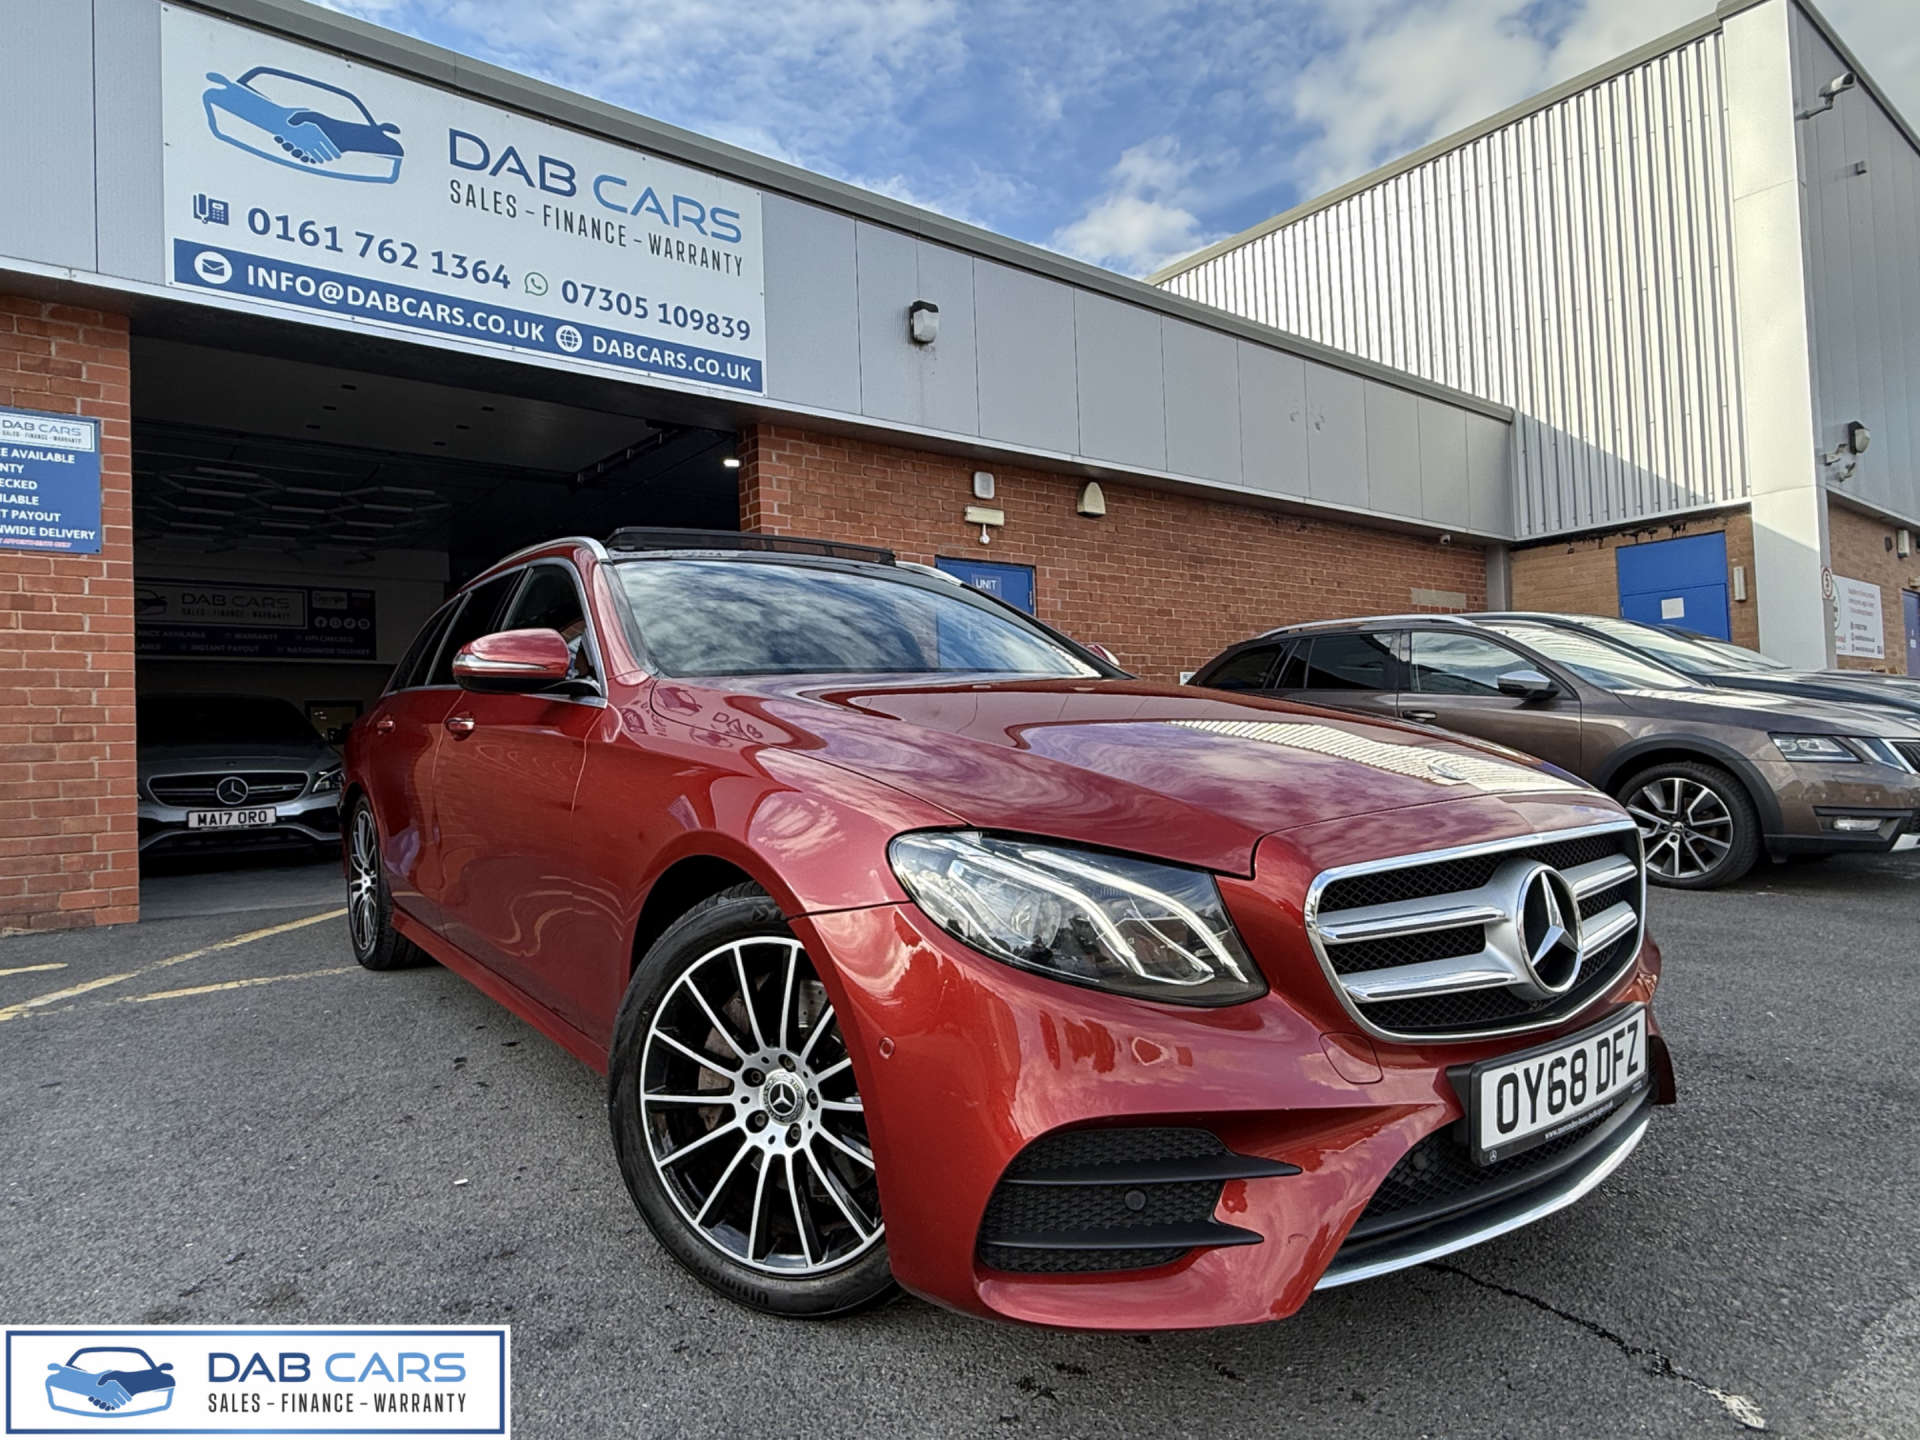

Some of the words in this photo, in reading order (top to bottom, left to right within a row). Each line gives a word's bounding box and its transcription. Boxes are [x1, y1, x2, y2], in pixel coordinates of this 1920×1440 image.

[449, 128, 577, 197] DAB
[593, 174, 742, 244] CARS
[450, 179, 517, 218] SALES
[543, 204, 627, 248] FINANCE
[648, 232, 743, 277] WARRANTY
[248, 207, 344, 253] 0161
[355, 231, 418, 269] 762
[431, 250, 511, 289] 1364
[561, 279, 649, 319] 07305
[657, 303, 751, 341] 109839
[247, 265, 545, 342] INFO@DABCARS.CO.UK
[592, 335, 752, 383] DABCARS.CO.UK
[2, 420, 35, 431] DAB
[38, 423, 82, 437] CARS
[11, 448, 75, 464] AVAILABLE
[11, 509, 62, 522] PAYOUT
[39, 526, 96, 540] DELIVERY
[975, 578, 997, 590] UNIT
[181, 592, 226, 608] DAB
[231, 594, 290, 610] CARS
[197, 812, 232, 827] MA17
[237, 810, 267, 824] ORO
[1496, 1047, 1588, 1135] OY68
[1596, 1019, 1639, 1096] DFZ
